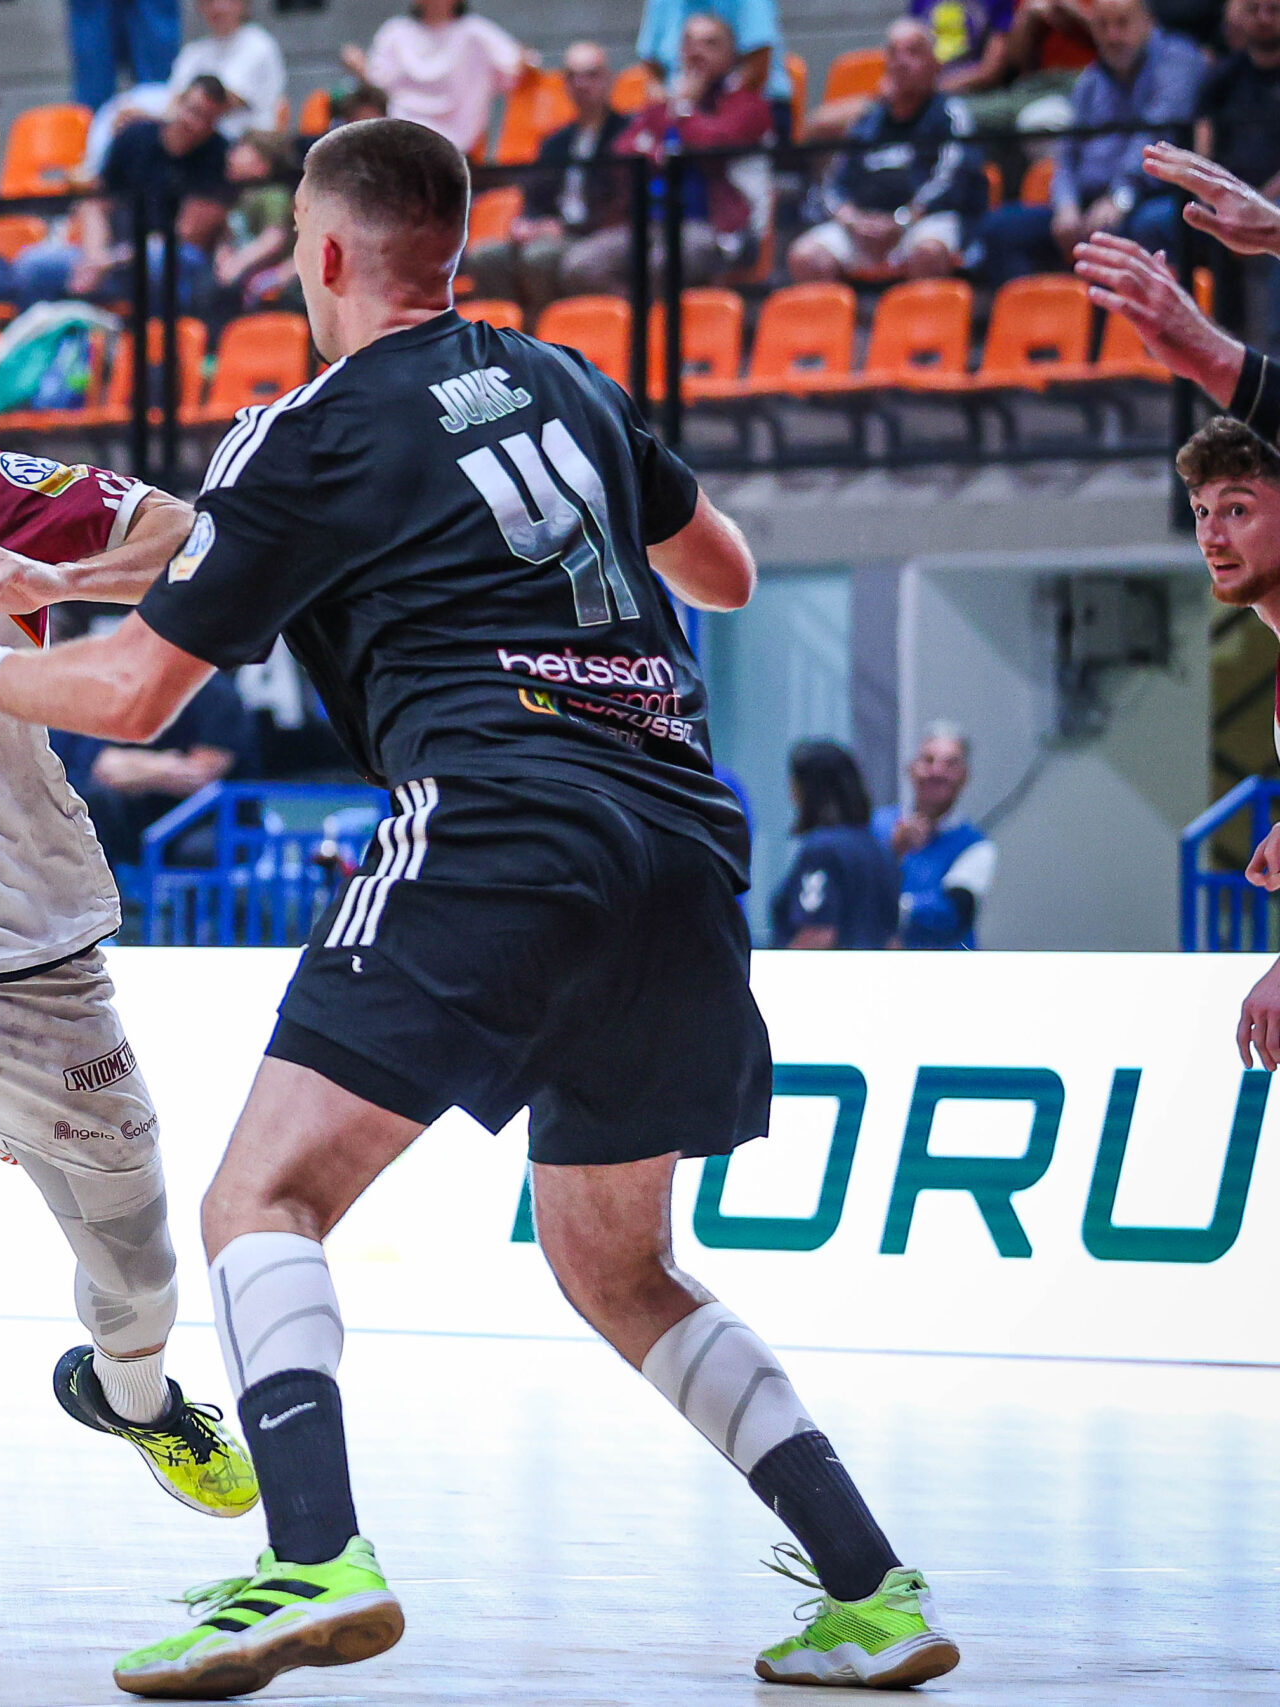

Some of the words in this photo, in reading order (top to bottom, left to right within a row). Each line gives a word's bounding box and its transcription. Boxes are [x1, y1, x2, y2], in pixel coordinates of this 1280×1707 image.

[427, 366, 533, 434] JOKIC
[456, 418, 640, 627] 41
[54, 1120, 115, 1140] Angelo
